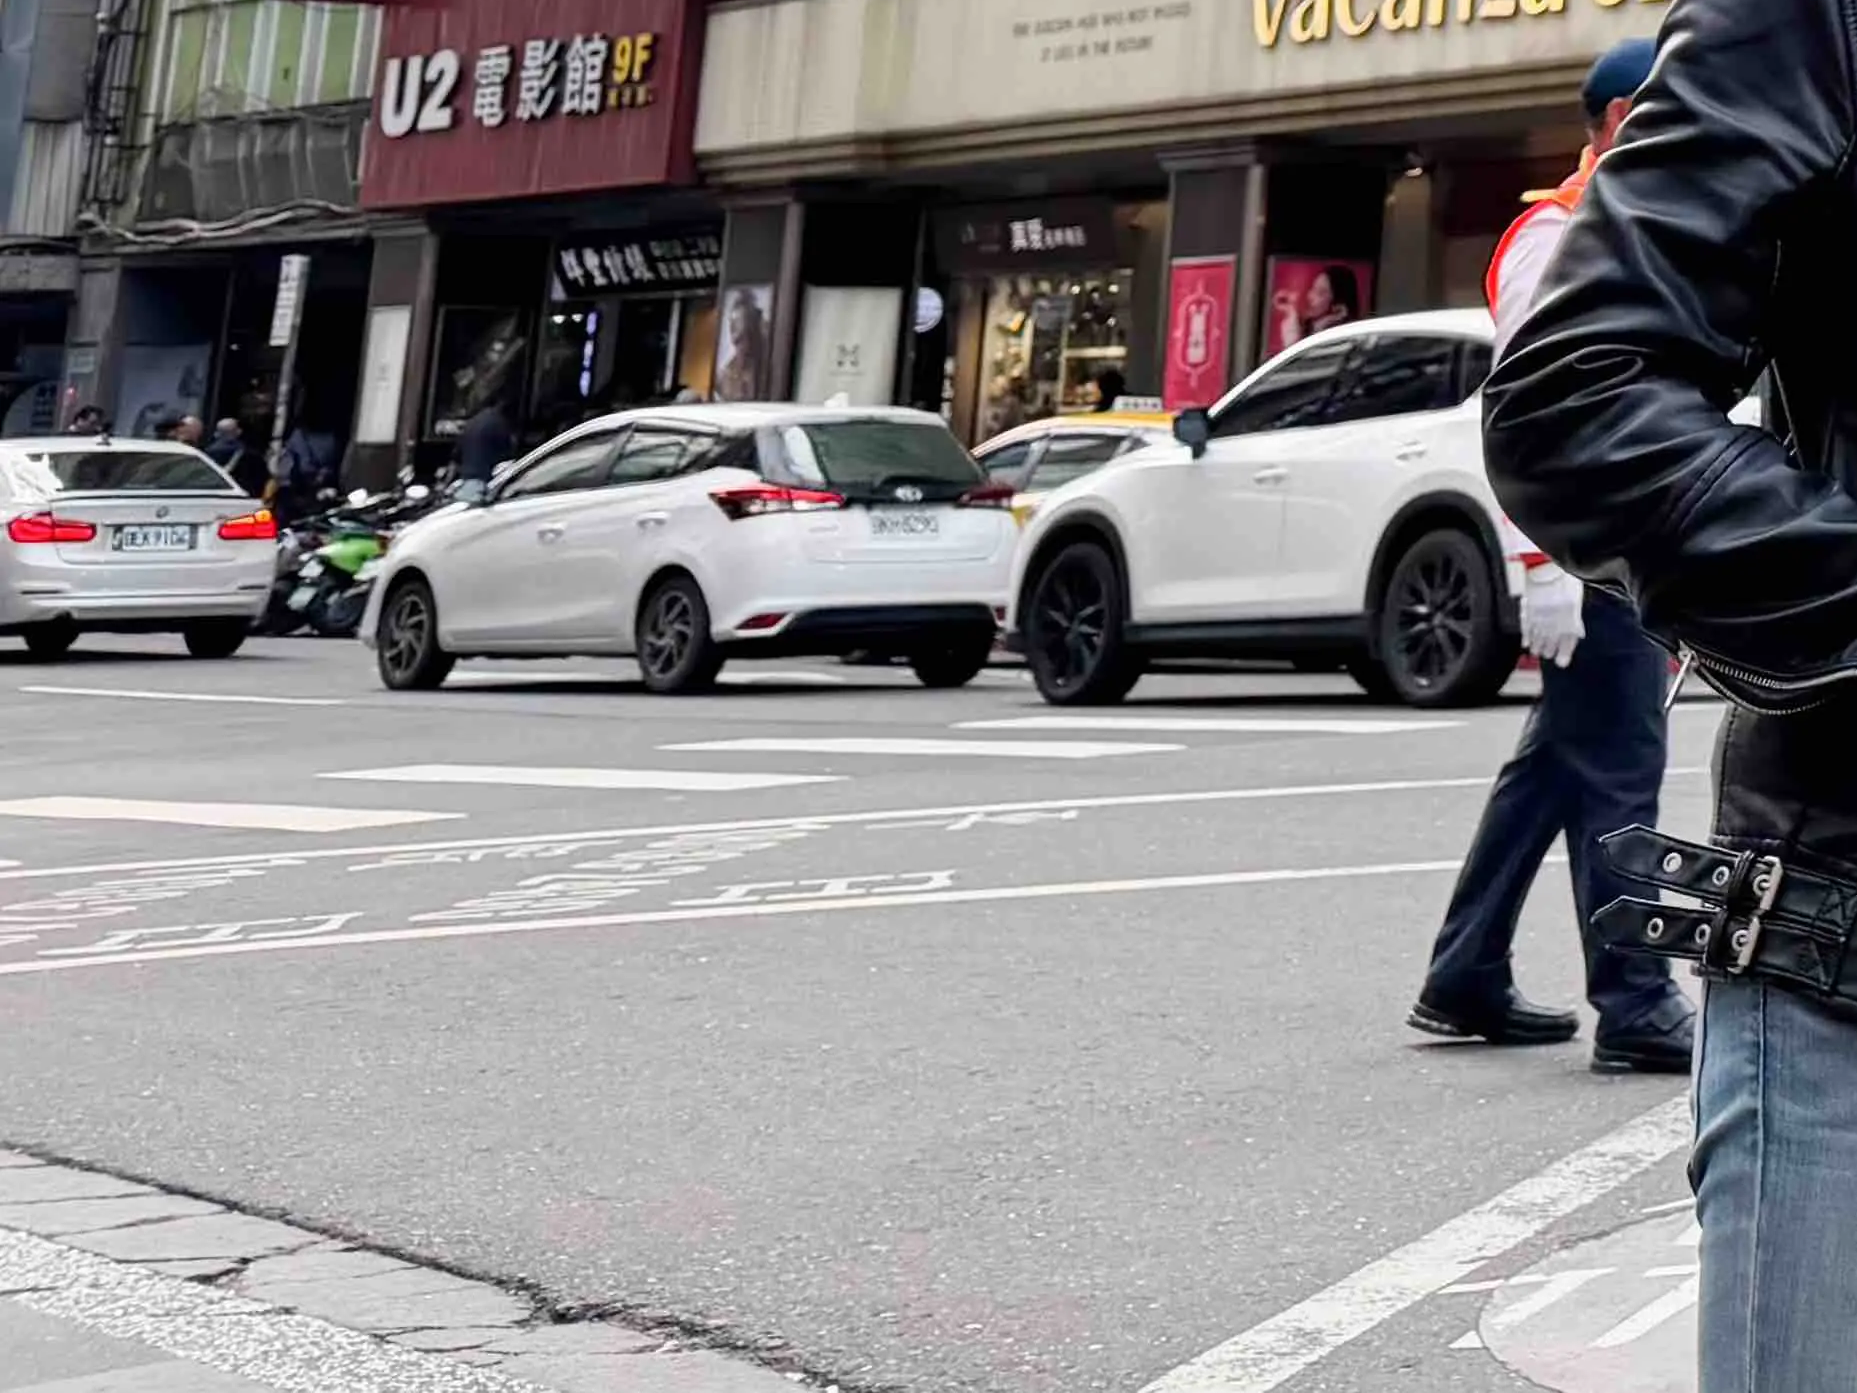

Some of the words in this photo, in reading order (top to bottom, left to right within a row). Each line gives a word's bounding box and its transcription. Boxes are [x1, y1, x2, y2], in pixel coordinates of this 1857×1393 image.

[380, 49, 460, 138] U2
[473, 32, 607, 128] 電影館
[612, 31, 653, 84] 9F
